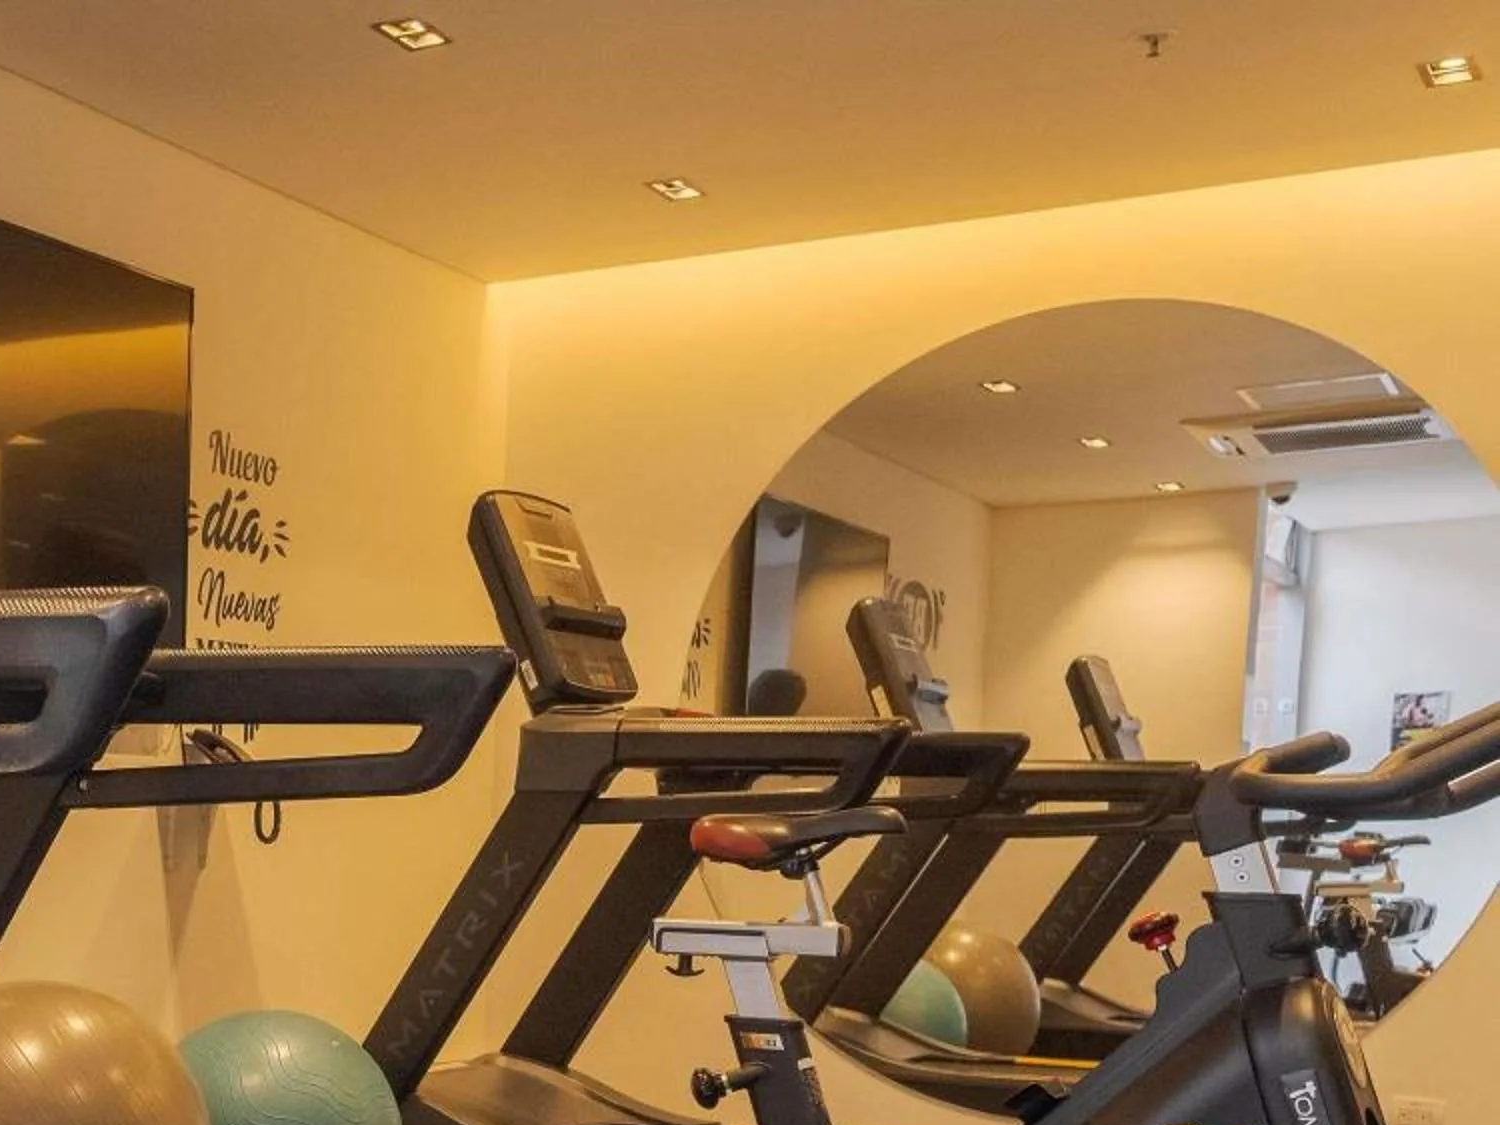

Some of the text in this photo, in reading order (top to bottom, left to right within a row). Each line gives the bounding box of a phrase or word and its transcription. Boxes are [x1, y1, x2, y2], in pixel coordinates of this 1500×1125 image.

[209, 429, 279, 486] Nuevo
[197, 567, 280, 632] Nuevas
[388, 850, 524, 1057] MATRIX
